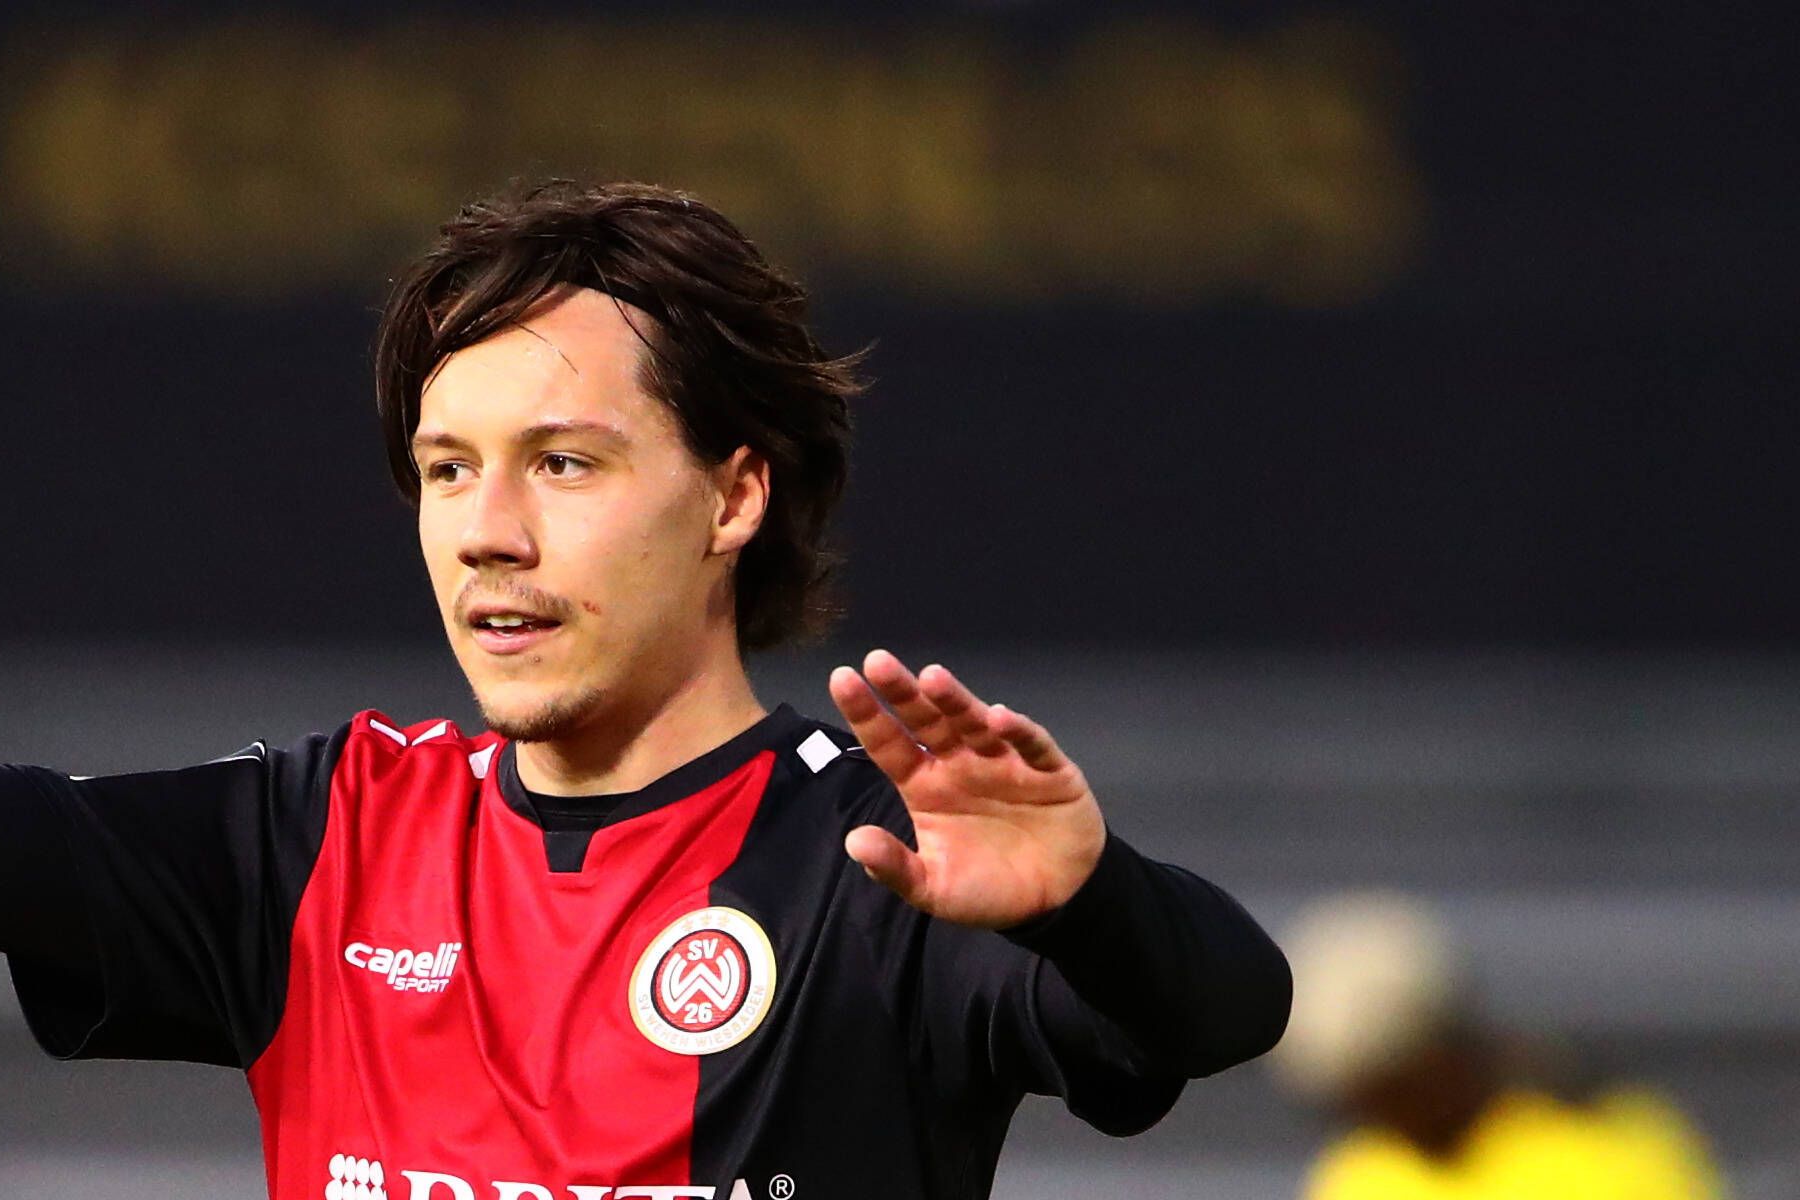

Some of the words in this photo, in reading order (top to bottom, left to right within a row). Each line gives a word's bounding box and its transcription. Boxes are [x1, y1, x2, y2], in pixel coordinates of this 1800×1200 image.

[687, 938, 718, 961] SV
[344, 942, 463, 985] capelli
[393, 976, 450, 993] SPORT
[683, 1002, 713, 1024] 26
